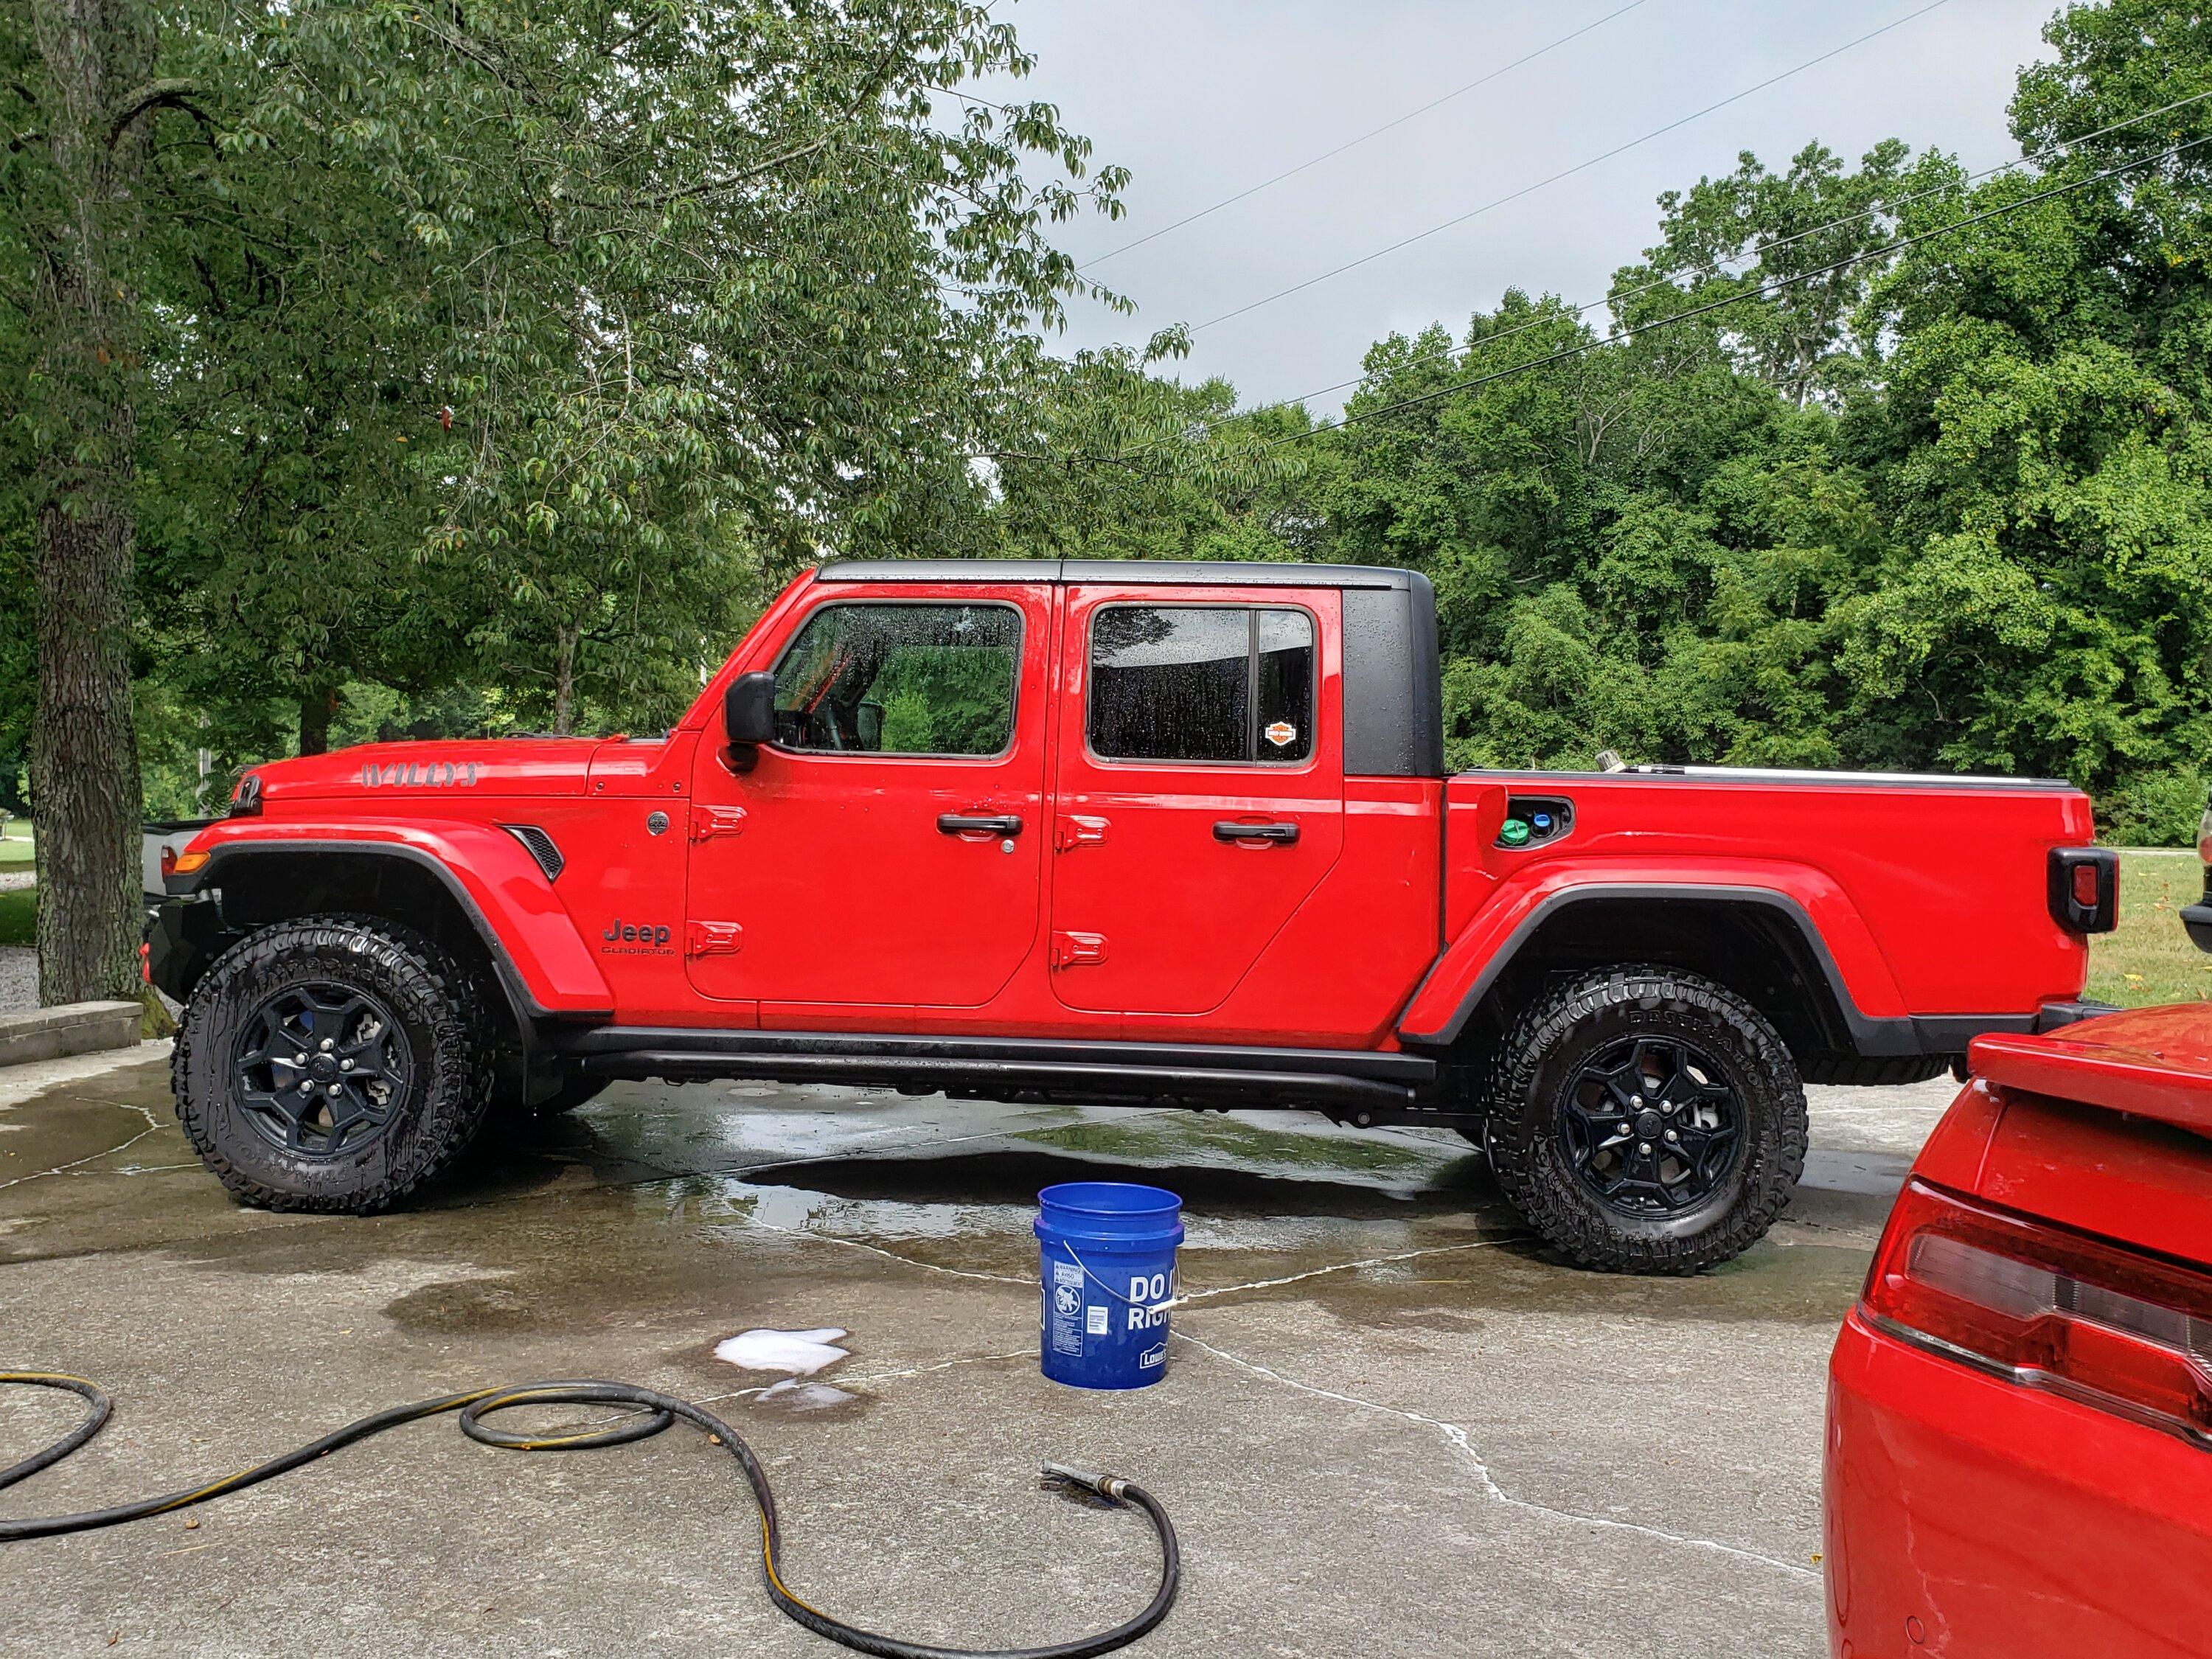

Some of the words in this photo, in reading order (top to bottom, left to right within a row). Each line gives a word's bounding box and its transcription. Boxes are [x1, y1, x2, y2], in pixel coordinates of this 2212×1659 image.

[361, 762, 484, 787] WILLYS
[602, 918, 671, 947] Jeep
[601, 946, 676, 956] GLADIATOR
[1130, 1273, 1165, 1302] DO
